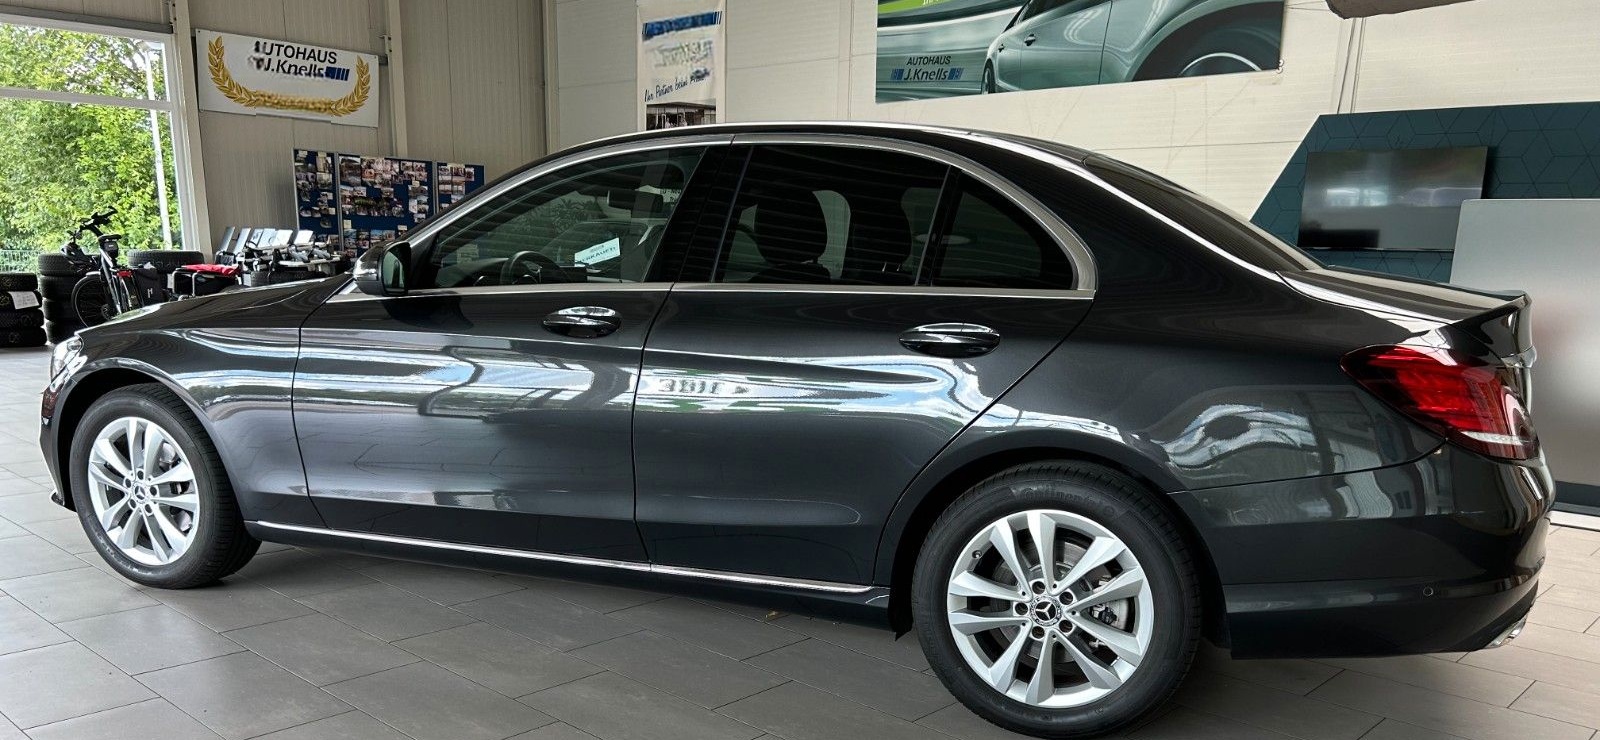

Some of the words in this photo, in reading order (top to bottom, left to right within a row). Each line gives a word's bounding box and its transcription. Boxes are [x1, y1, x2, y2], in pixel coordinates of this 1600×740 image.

[264, 58, 324, 77] J.Knells
[906, 56, 951, 66] AUTOHAUS
[904, 67, 949, 80] J.Knells
